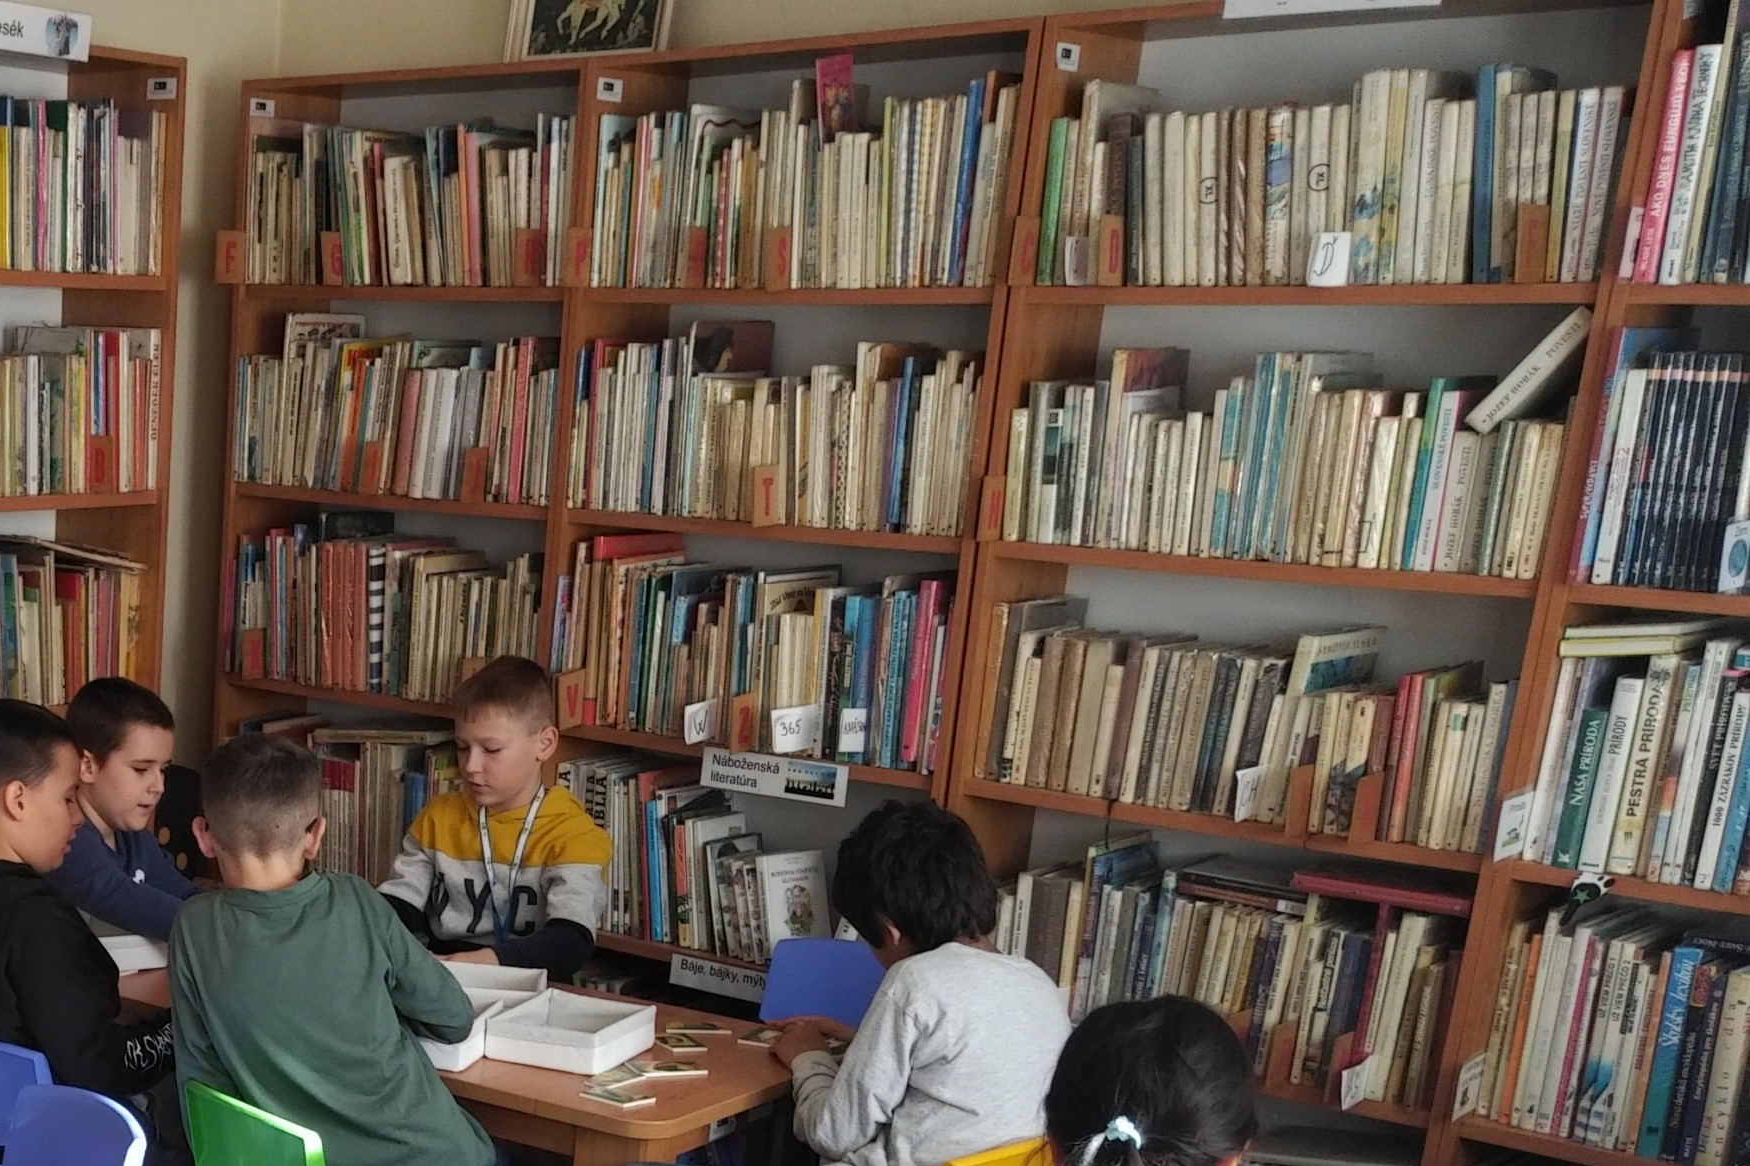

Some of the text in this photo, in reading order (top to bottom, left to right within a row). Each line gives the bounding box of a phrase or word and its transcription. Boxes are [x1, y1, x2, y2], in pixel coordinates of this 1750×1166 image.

[1675, 60, 1690, 91] VECI
[1662, 94, 1683, 151] FUNGUJÚ
[1655, 155, 1671, 188] DNES
[1649, 192, 1665, 217] AKO
[1485, 389, 1512, 422] JOZEF
[1545, 321, 1582, 358] POVESTI
[150, 343, 161, 441] BENEDEK ELEK
[762, 476, 773, 517] T
[1444, 533, 1458, 560] JOZEF
[565, 684, 578, 719] V
[693, 709, 708, 735] W
[737, 705, 751, 744] Z
[780, 717, 802, 737] 365
[1606, 715, 1628, 755] PRÍRODY
[1638, 686, 1663, 752] PRÍRODA
[1577, 719, 1600, 770] PRÍRODA
[710, 769, 757, 788] literatúra
[712, 753, 780, 775] Náboženská
[1712, 704, 1746, 827] 1000 ZÁZRAKOV PRÍRODY
[1569, 772, 1590, 806] NAŠA
[680, 958, 706, 975] Báje,
[709, 965, 739, 984] bájky,
[1616, 967, 1629, 989] PREČO
[1599, 987, 1610, 1005] VIEM
[1613, 990, 1624, 1009] VIEM
[1658, 957, 1696, 1049] Školský lexikón
[1678, 1031, 1695, 1078] encyklopédia
